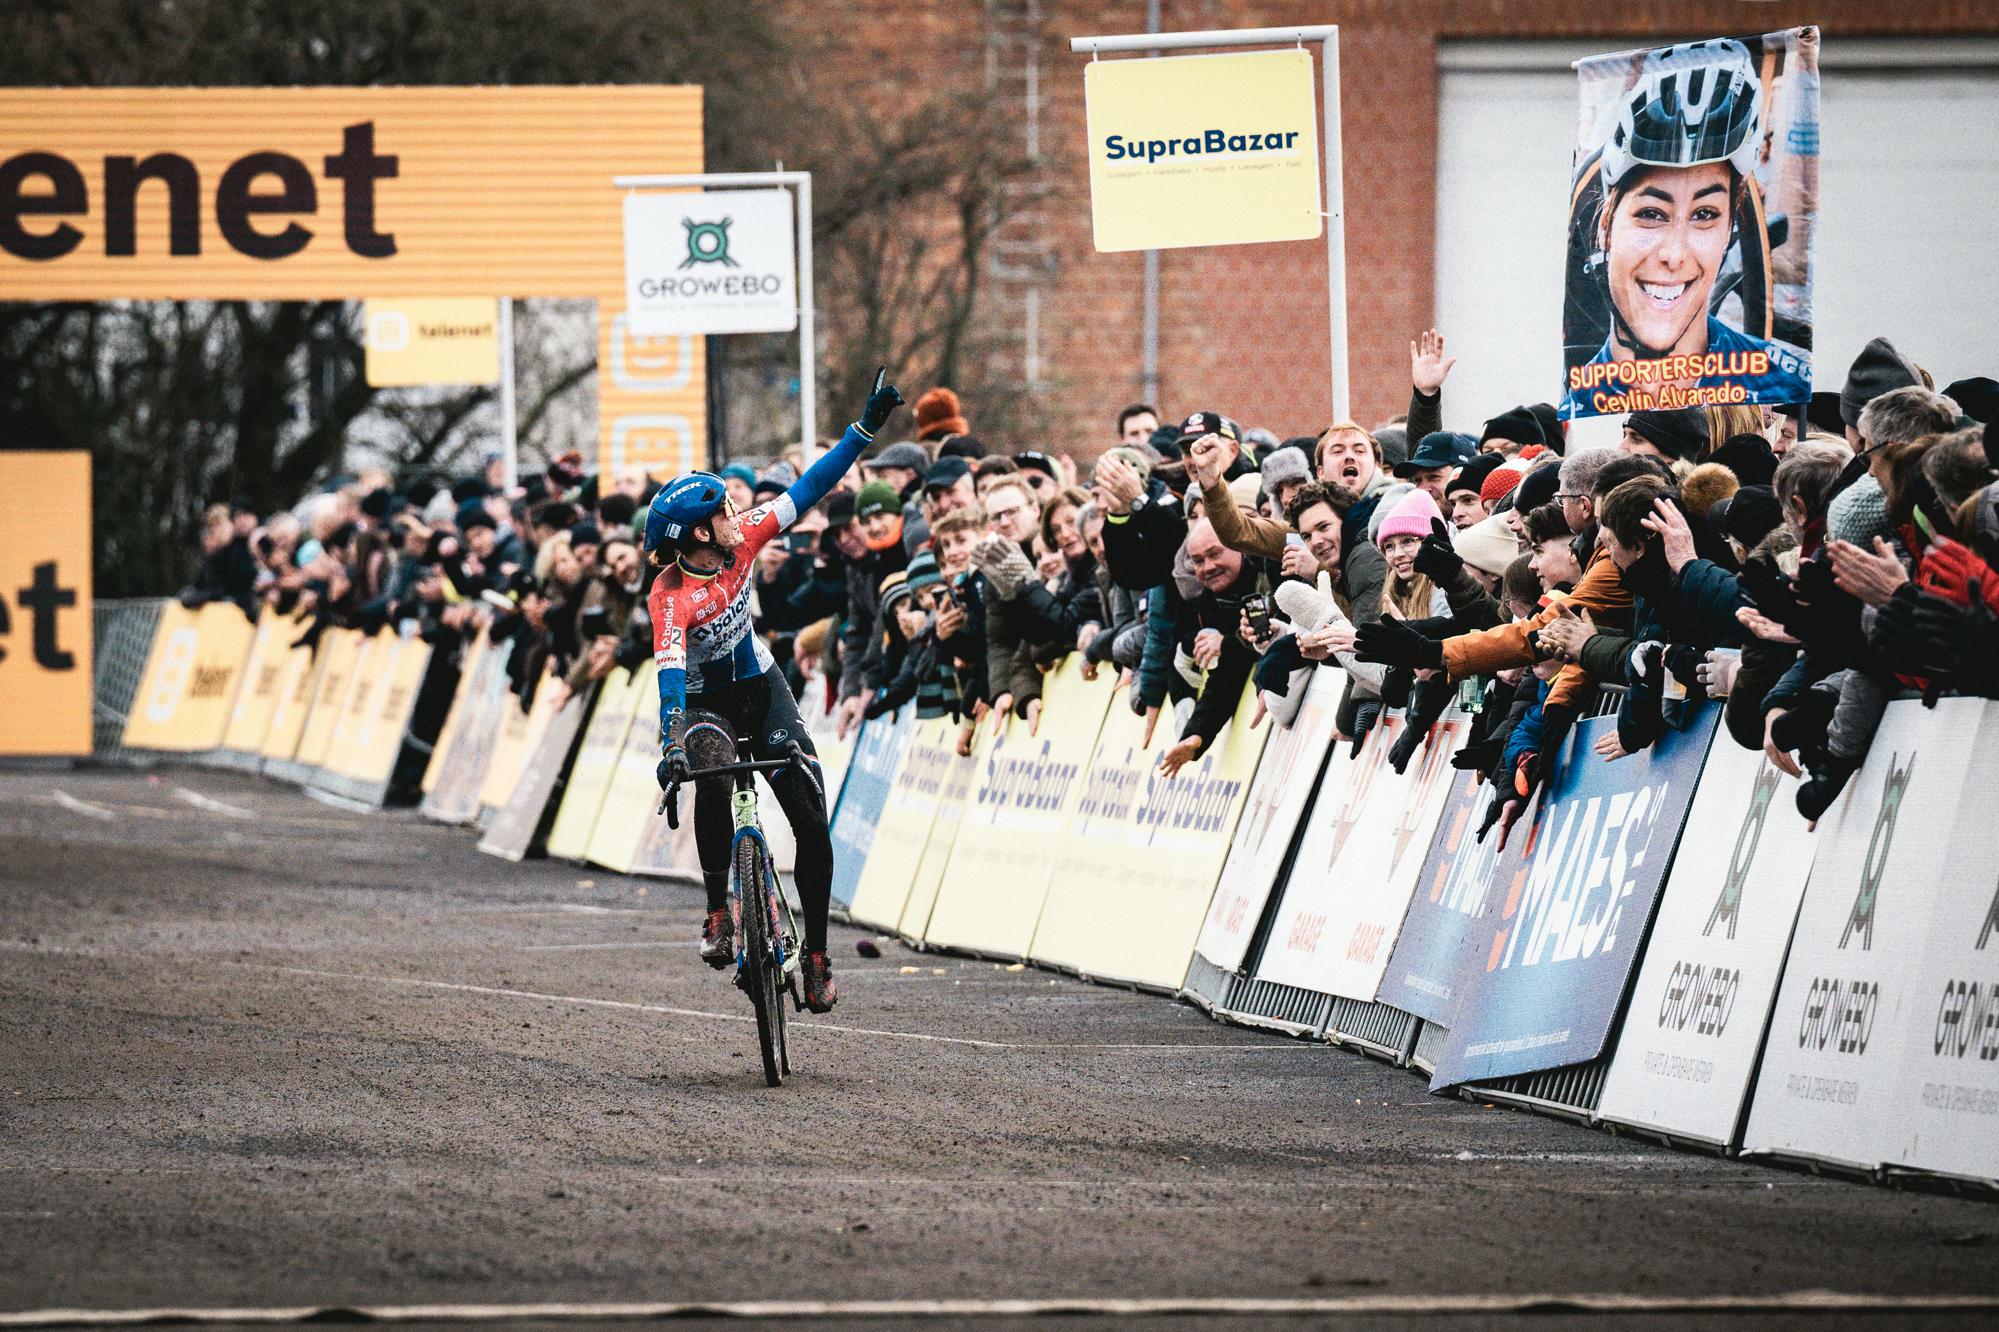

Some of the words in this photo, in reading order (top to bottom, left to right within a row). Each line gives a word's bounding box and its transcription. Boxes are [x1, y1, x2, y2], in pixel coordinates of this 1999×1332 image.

[1105, 129, 1299, 164] SupraBazar
[0, 121, 399, 261] enet
[639, 274, 780, 299] GROWEBO
[1569, 350, 1770, 391] SUPPORTERSCLUB
[1593, 389, 1653, 413] Ceylin
[1657, 381, 1747, 409] Alvarado
[664, 481, 702, 503] TREK
[0, 559, 76, 672] t
[663, 596, 675, 637] baloise
[671, 628, 682, 646] 2
[1135, 750, 1241, 847] SupraBazar
[1501, 785, 1652, 969] MAES
[1658, 960, 1740, 1038] GROWEBO
[1799, 976, 1878, 1056] GROWEBO
